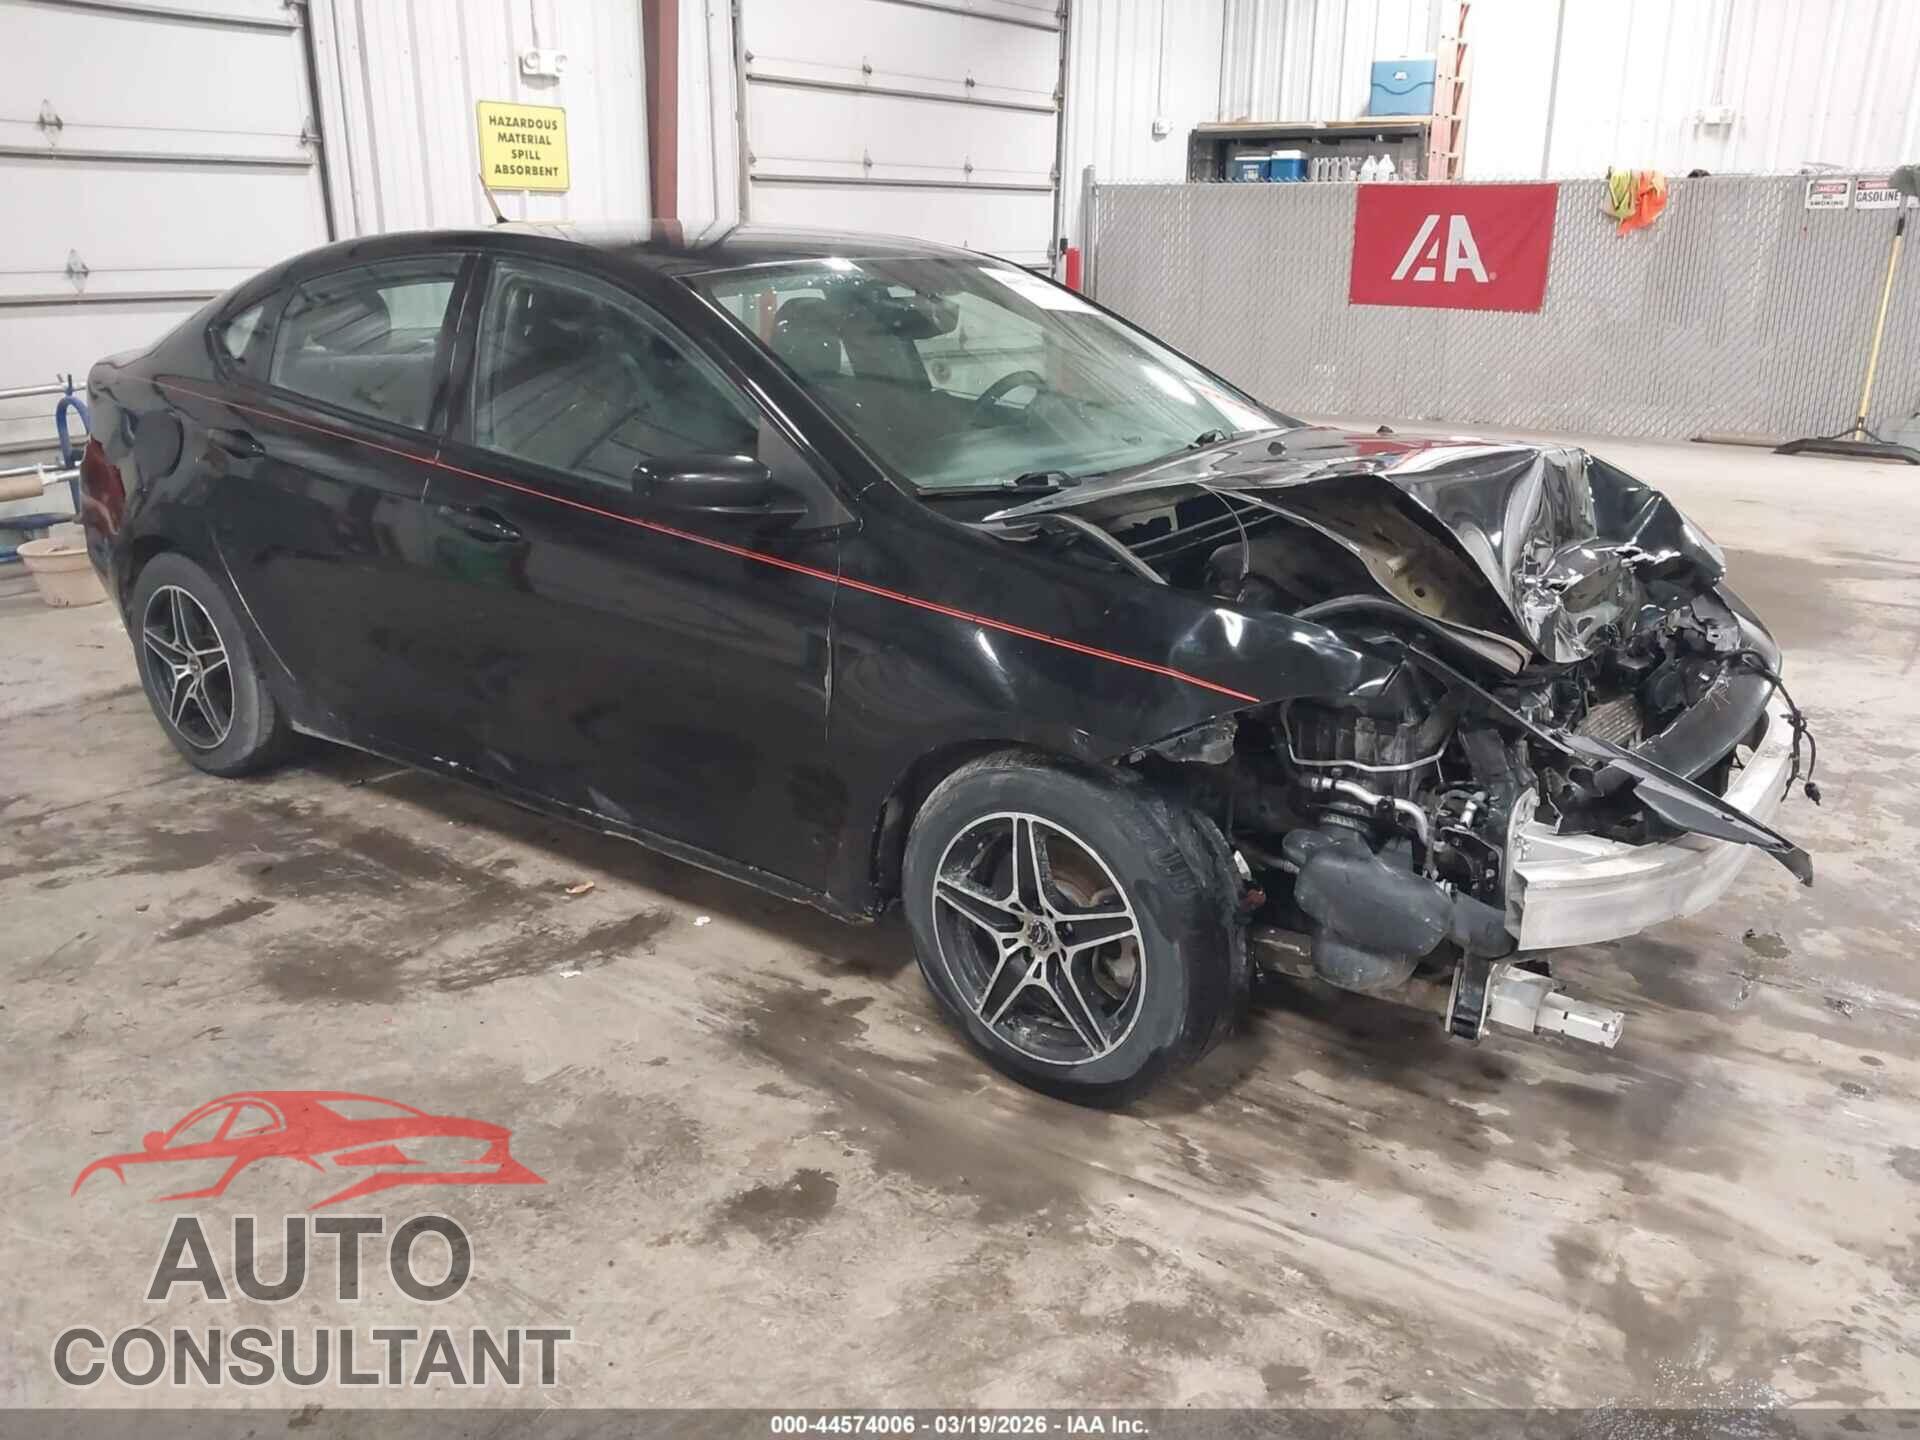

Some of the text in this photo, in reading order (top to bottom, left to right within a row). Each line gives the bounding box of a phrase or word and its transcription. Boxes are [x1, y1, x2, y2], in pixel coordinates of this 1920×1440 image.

[488, 115, 558, 131] HAZARDOUS
[497, 132, 552, 146] MATERIAL
[511, 149, 541, 161] SPILL
[494, 164, 559, 177] ABSORBENT
[1856, 191, 1899, 202] GASOLINE
